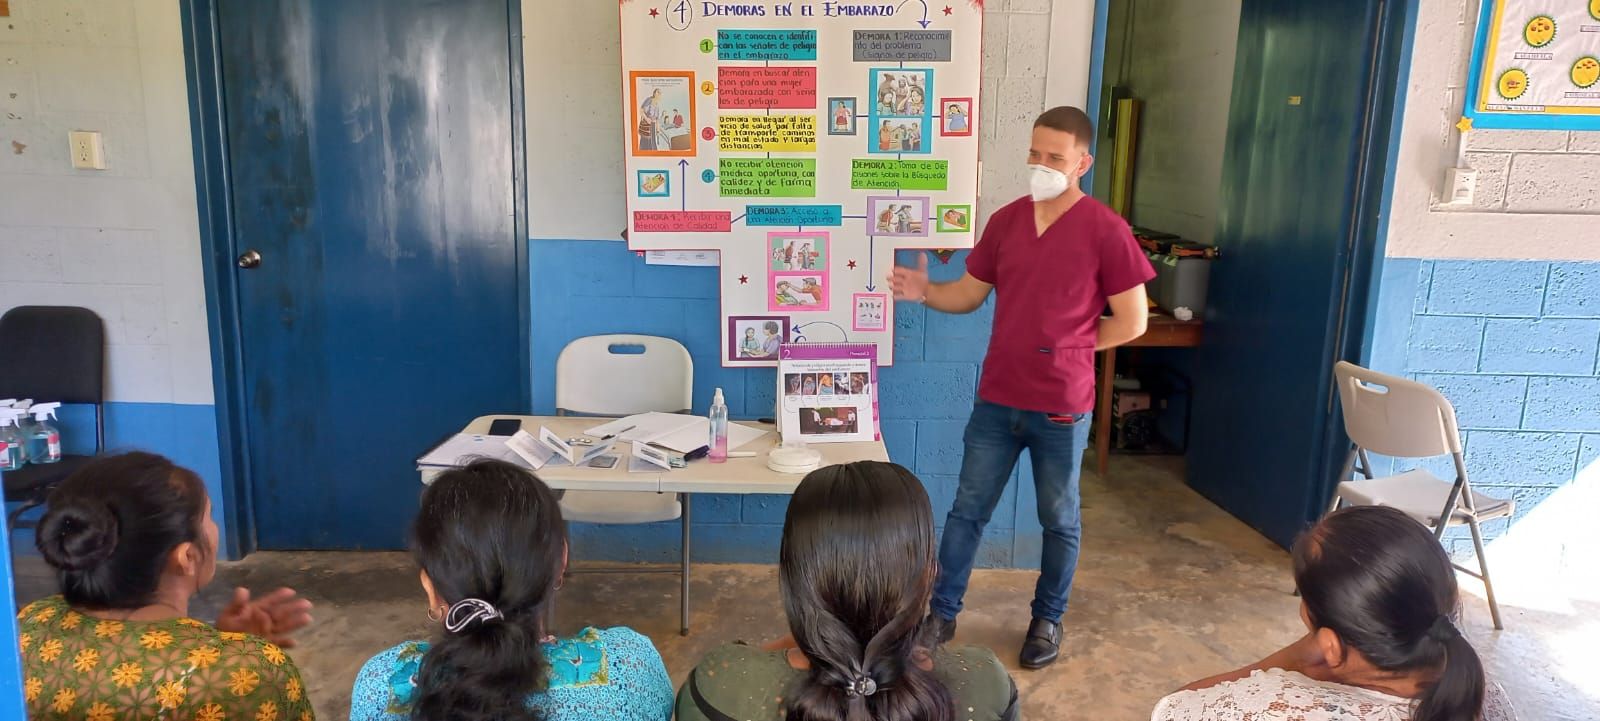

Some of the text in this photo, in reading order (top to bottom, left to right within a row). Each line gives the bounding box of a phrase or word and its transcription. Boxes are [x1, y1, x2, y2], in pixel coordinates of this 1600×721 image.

[672, 0, 894, 23] 4 DEMORAS EN EL EMBARAZO
[718, 31, 729, 40] No
[855, 31, 891, 41] DEMORA
[736, 41, 747, 49] las
[780, 41, 790, 49] de
[792, 42, 816, 52] peligro
[870, 40, 882, 49] del
[885, 40, 922, 50] problema
[733, 51, 741, 59] el
[745, 51, 789, 59] embarazo
[895, 50, 905, 59] de
[719, 69, 750, 77] Demora
[764, 69, 790, 77] buscar
[740, 79, 760, 87] para
[781, 79, 802, 89] mujer
[719, 87, 774, 96] embarazada
[719, 97, 779, 108] les de peligro
[763, 116, 785, 125] llegar
[789, 115, 797, 123] al
[739, 122, 749, 130] de
[776, 122, 788, 131] por
[792, 122, 813, 130] falta
[791, 136, 816, 145] largas
[720, 160, 732, 168] No
[735, 160, 763, 168] recibir
[852, 160, 886, 169] DEMORA
[899, 160, 917, 169] Toma
[920, 162, 931, 170] de
[720, 178, 755, 186] calidez
[757, 178, 762, 187] y
[766, 178, 777, 186] de
[852, 179, 863, 187] de
[746, 205, 778, 215] DEMORA
[791, 205, 818, 215] Acceso
[822, 207, 829, 215] a
[634, 212, 667, 221] DEMORA
[715, 212, 730, 221] una
[673, 221, 685, 230] de
[687, 221, 718, 231] Calidad
[783, 349, 792, 360] 2
